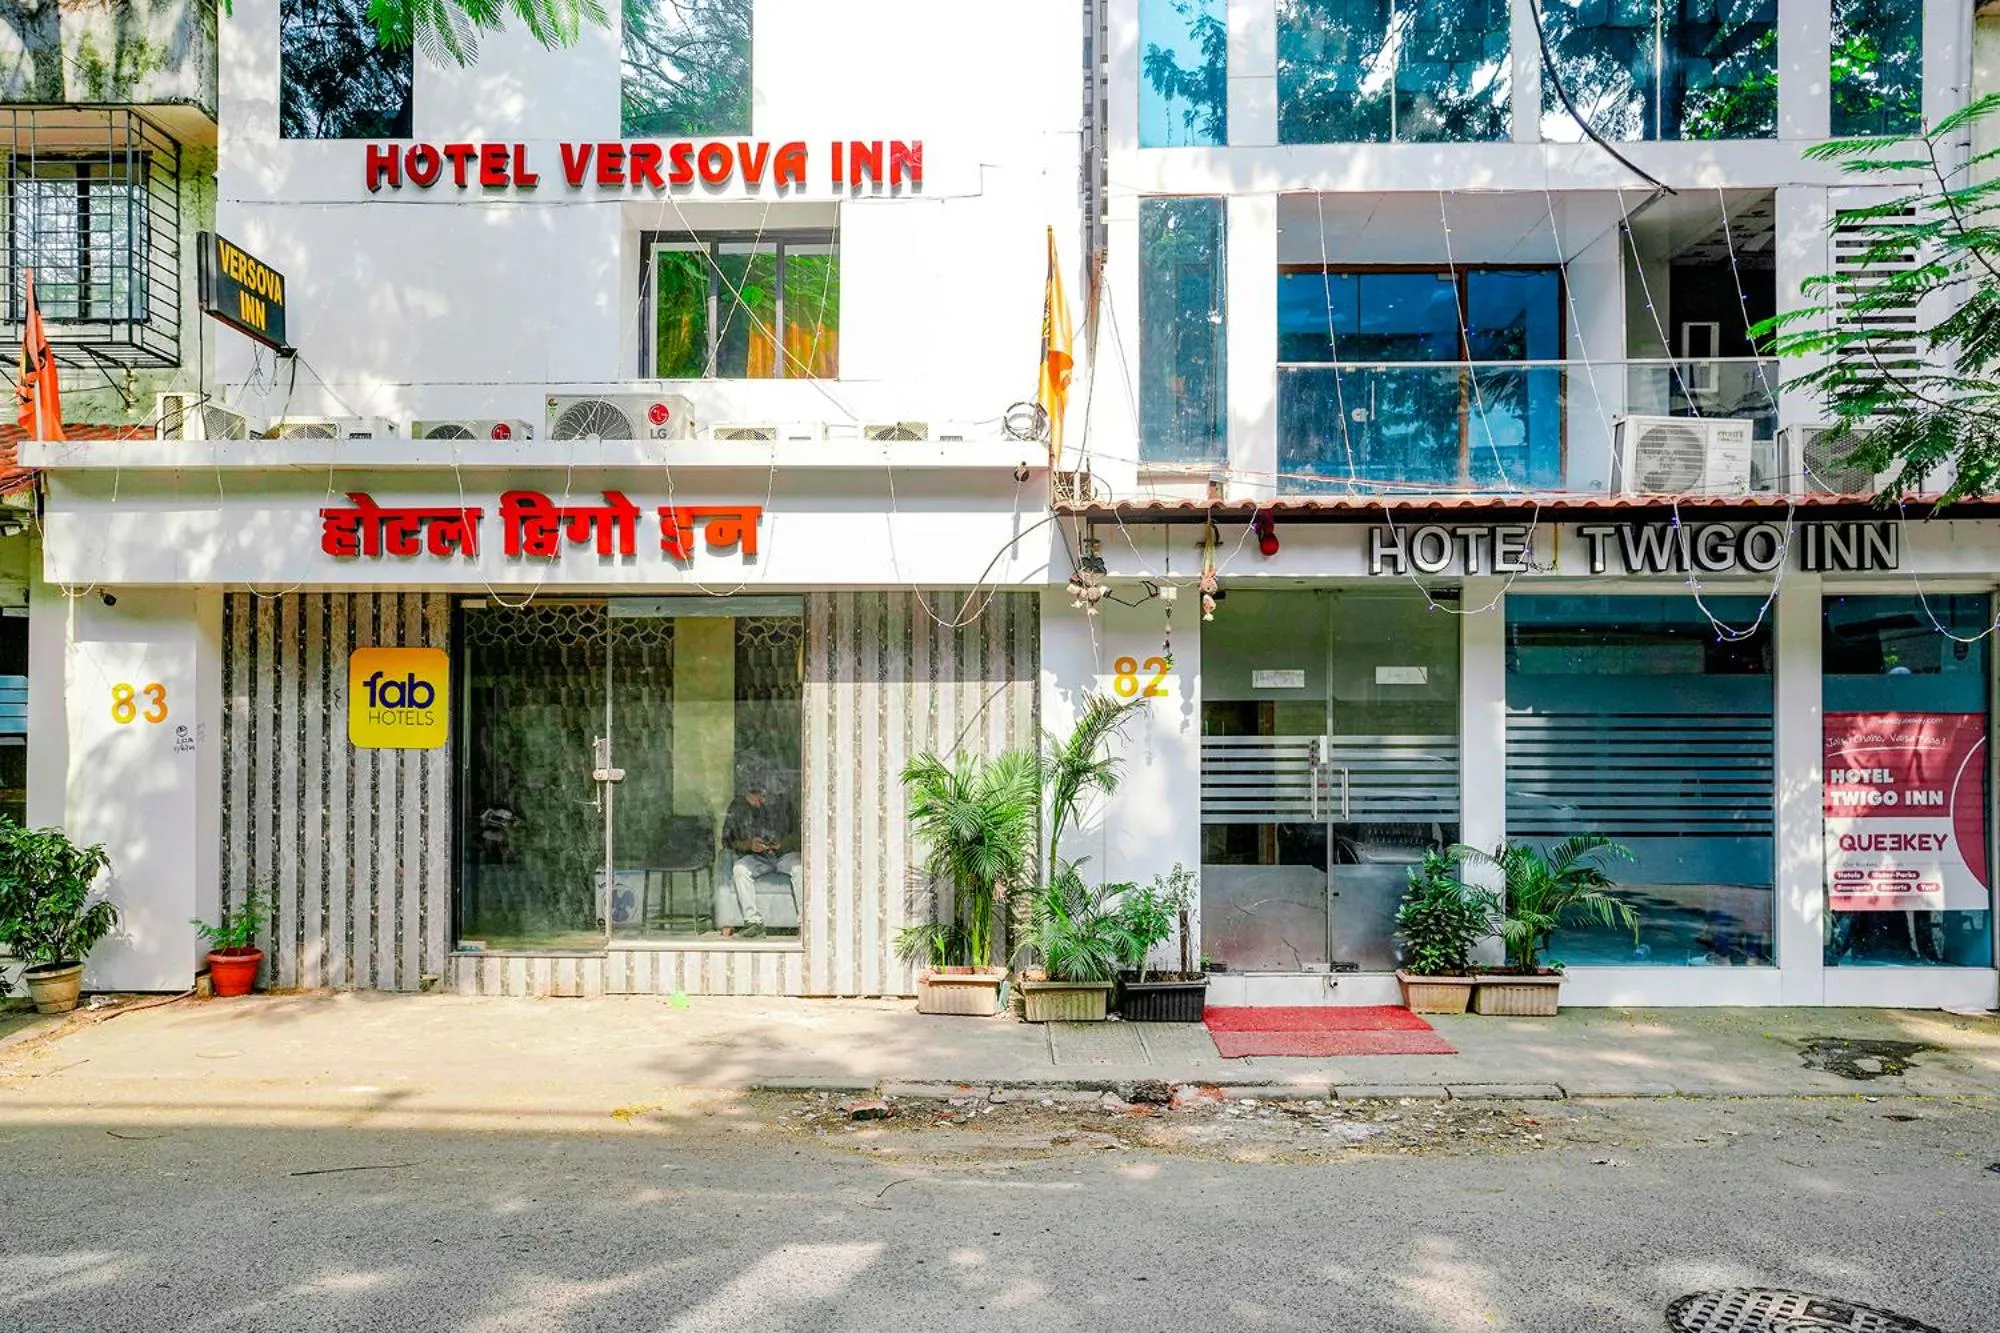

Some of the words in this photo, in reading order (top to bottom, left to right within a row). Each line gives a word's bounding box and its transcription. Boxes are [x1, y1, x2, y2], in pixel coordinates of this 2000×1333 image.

[366, 143, 539, 191] HOTEL
[560, 141, 808, 191] VERSOVA
[832, 140, 924, 190] INN
[218, 240, 283, 306] VERSOVA
[240, 290, 266, 332] INN
[650, 428, 668, 440] LG
[319, 491, 484, 558] होटल
[658, 506, 763, 562] इन
[1369, 525, 1529, 573] HOTE
[1579, 524, 1785, 573] TWIGO
[1804, 522, 1899, 572] INN
[362, 671, 435, 709] fab
[1114, 656, 1169, 698] 82
[111, 683, 168, 724] 83
[368, 710, 434, 726] HOTELS
[1830, 769, 1894, 784] HOTEL
[1830, 790, 1899, 806] TWIGO
[1905, 790, 1944, 806] INN
